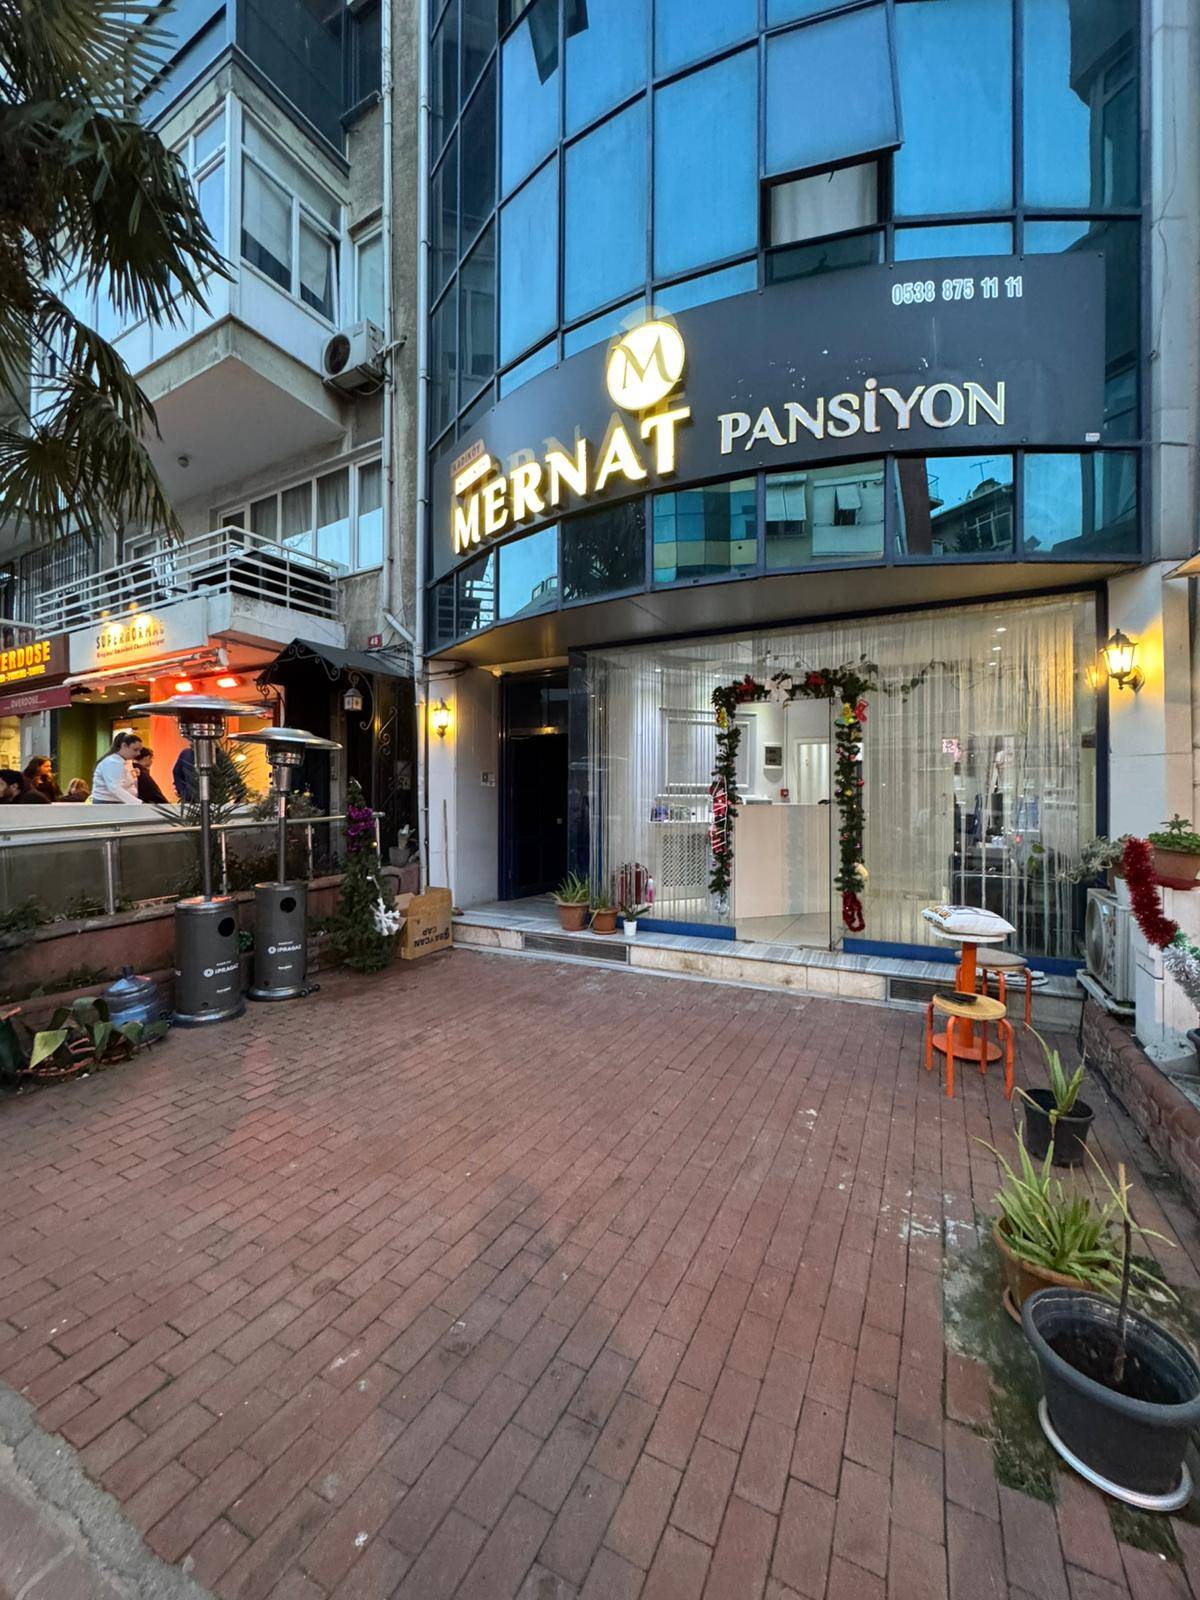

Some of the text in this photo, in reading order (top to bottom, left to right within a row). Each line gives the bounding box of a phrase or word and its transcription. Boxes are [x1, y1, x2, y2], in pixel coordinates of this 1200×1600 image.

[891, 275, 1023, 306] 0538 875 11 11
[609, 333, 684, 391] M
[454, 406, 691, 555] MERNAT
[0, 640, 50, 672] ERDOSE
